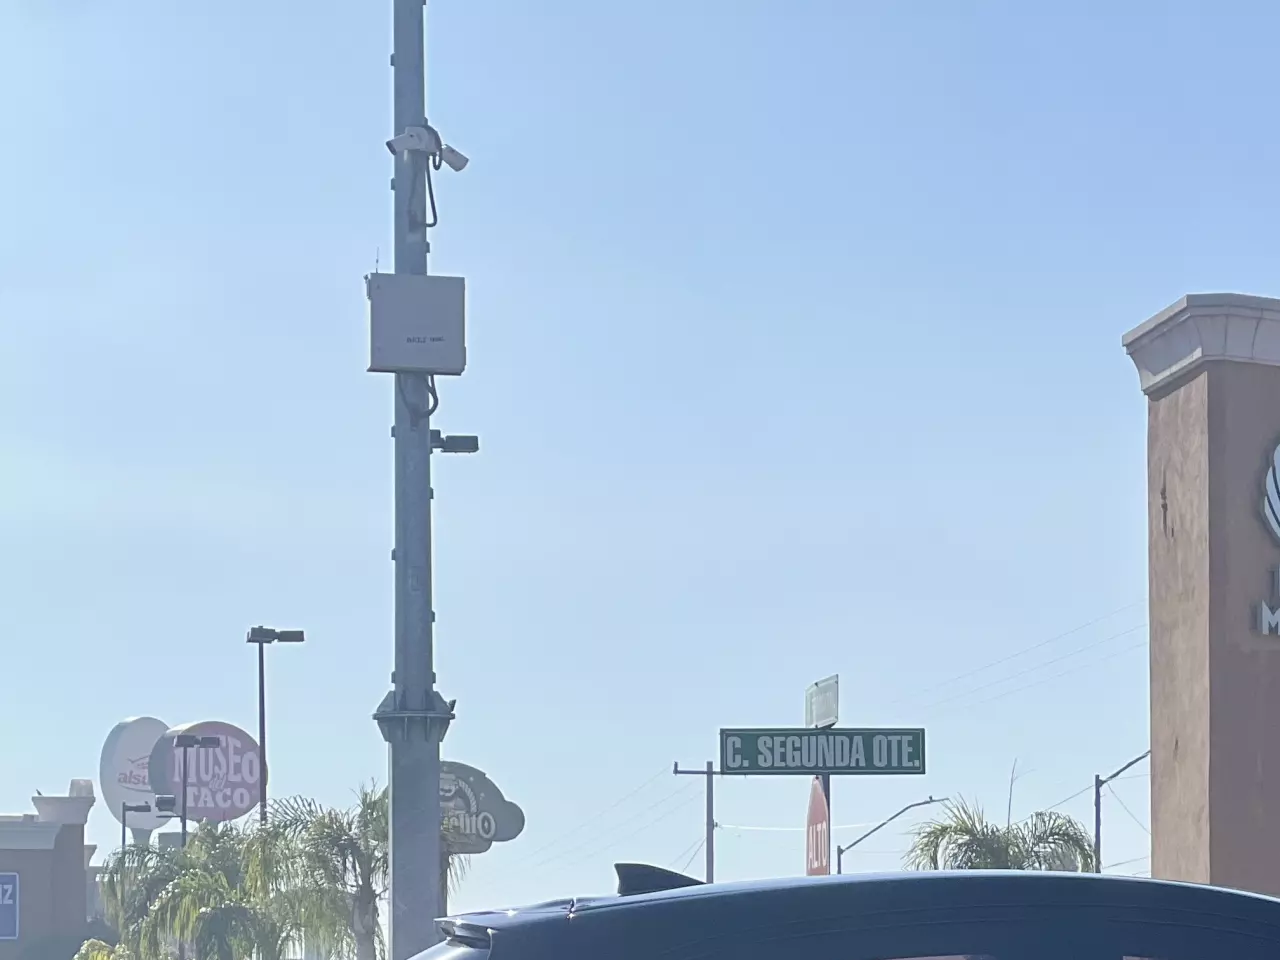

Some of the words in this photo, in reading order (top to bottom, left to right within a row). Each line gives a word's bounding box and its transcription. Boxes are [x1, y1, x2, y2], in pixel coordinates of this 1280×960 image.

[173, 735, 260, 784] MUSEO
[726, 737, 749, 768] C.
[757, 735, 866, 768] SEGUNDA
[872, 735, 920, 768] OTE.
[186, 787, 250, 809] TACO
[808, 820, 828, 869] ALTO
